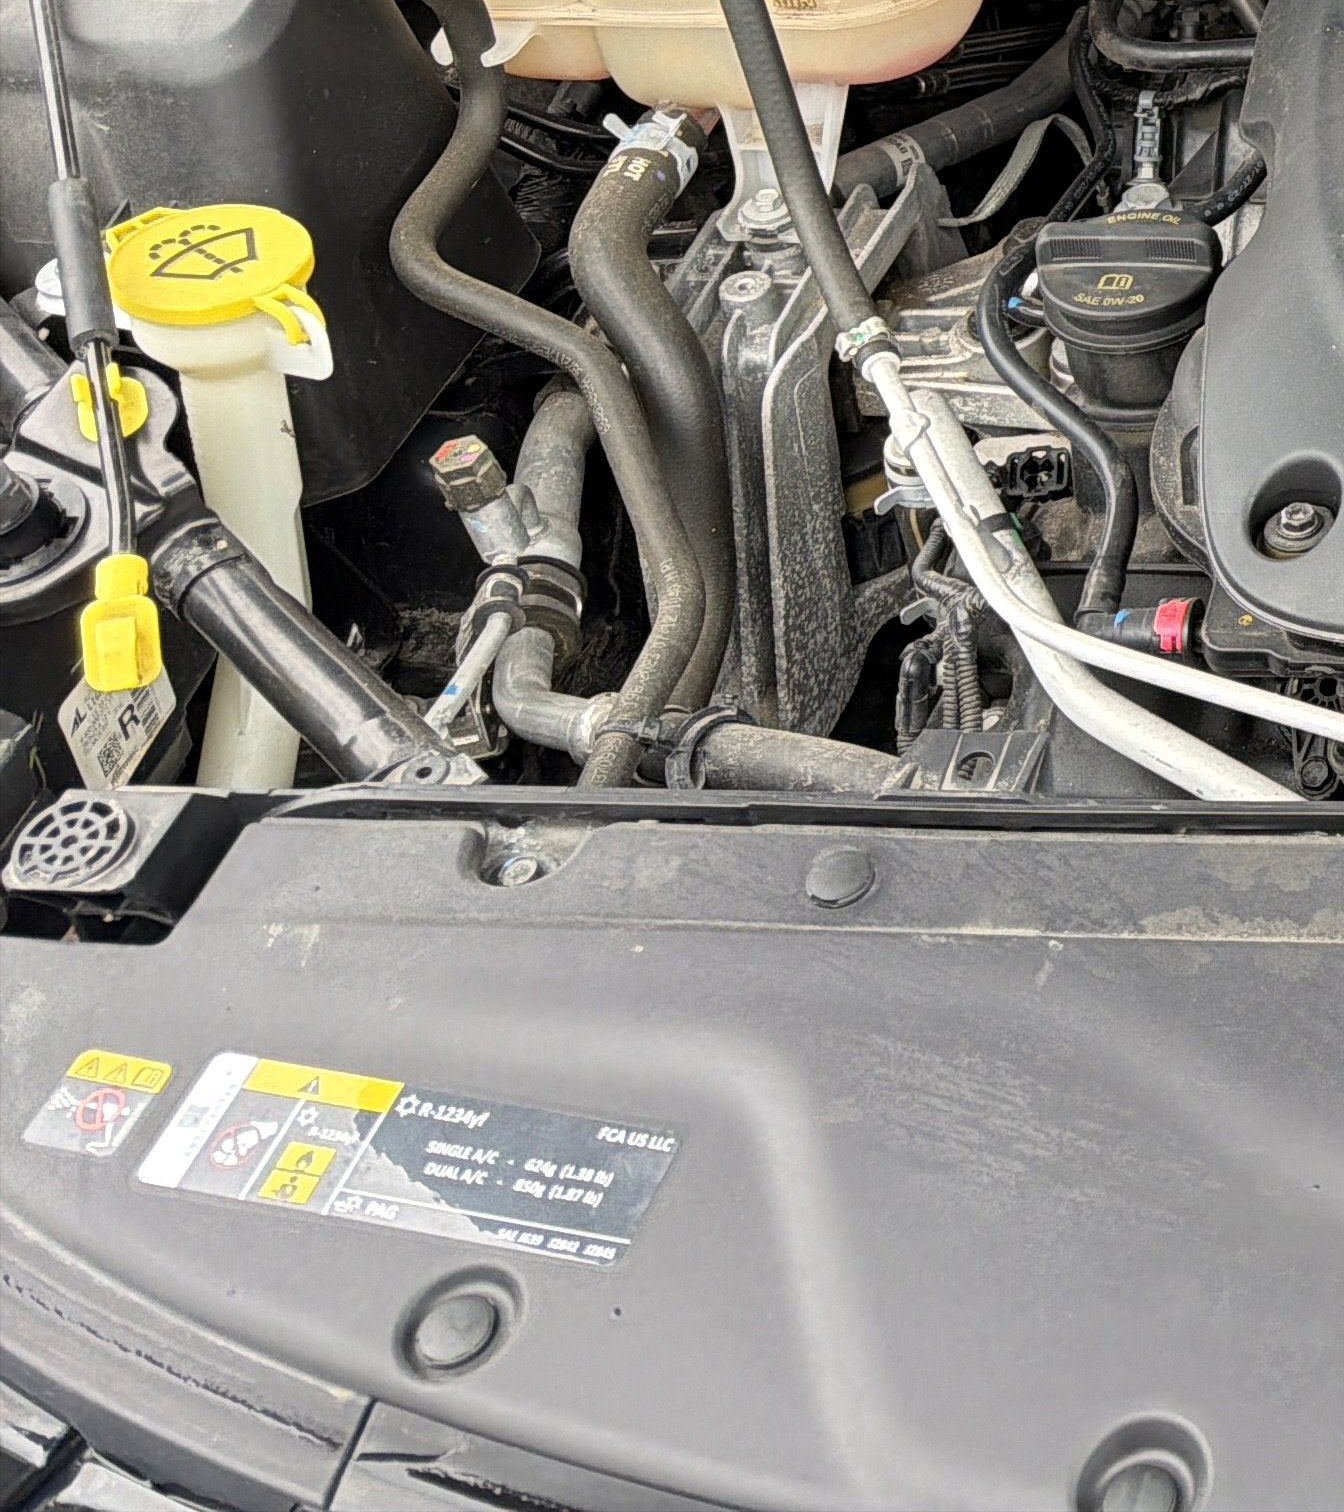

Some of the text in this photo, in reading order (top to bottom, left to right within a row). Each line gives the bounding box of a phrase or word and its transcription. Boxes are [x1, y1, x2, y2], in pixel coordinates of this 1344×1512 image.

[623, 156, 652, 183] HOT
[1106, 213, 1182, 226] ENGINE OIL
[1073, 292, 1145, 306] SAE 0W-20
[118, 703, 140, 741] R
[596, 1126, 677, 1153] FCA US LLC
[425, 1140, 474, 1160] SINGLE
[471, 1148, 500, 1165] A/C
[423, 1161, 460, 1181] DUAL
[460, 1169, 489, 1185] A/C
[364, 1200, 400, 1221] PAG
